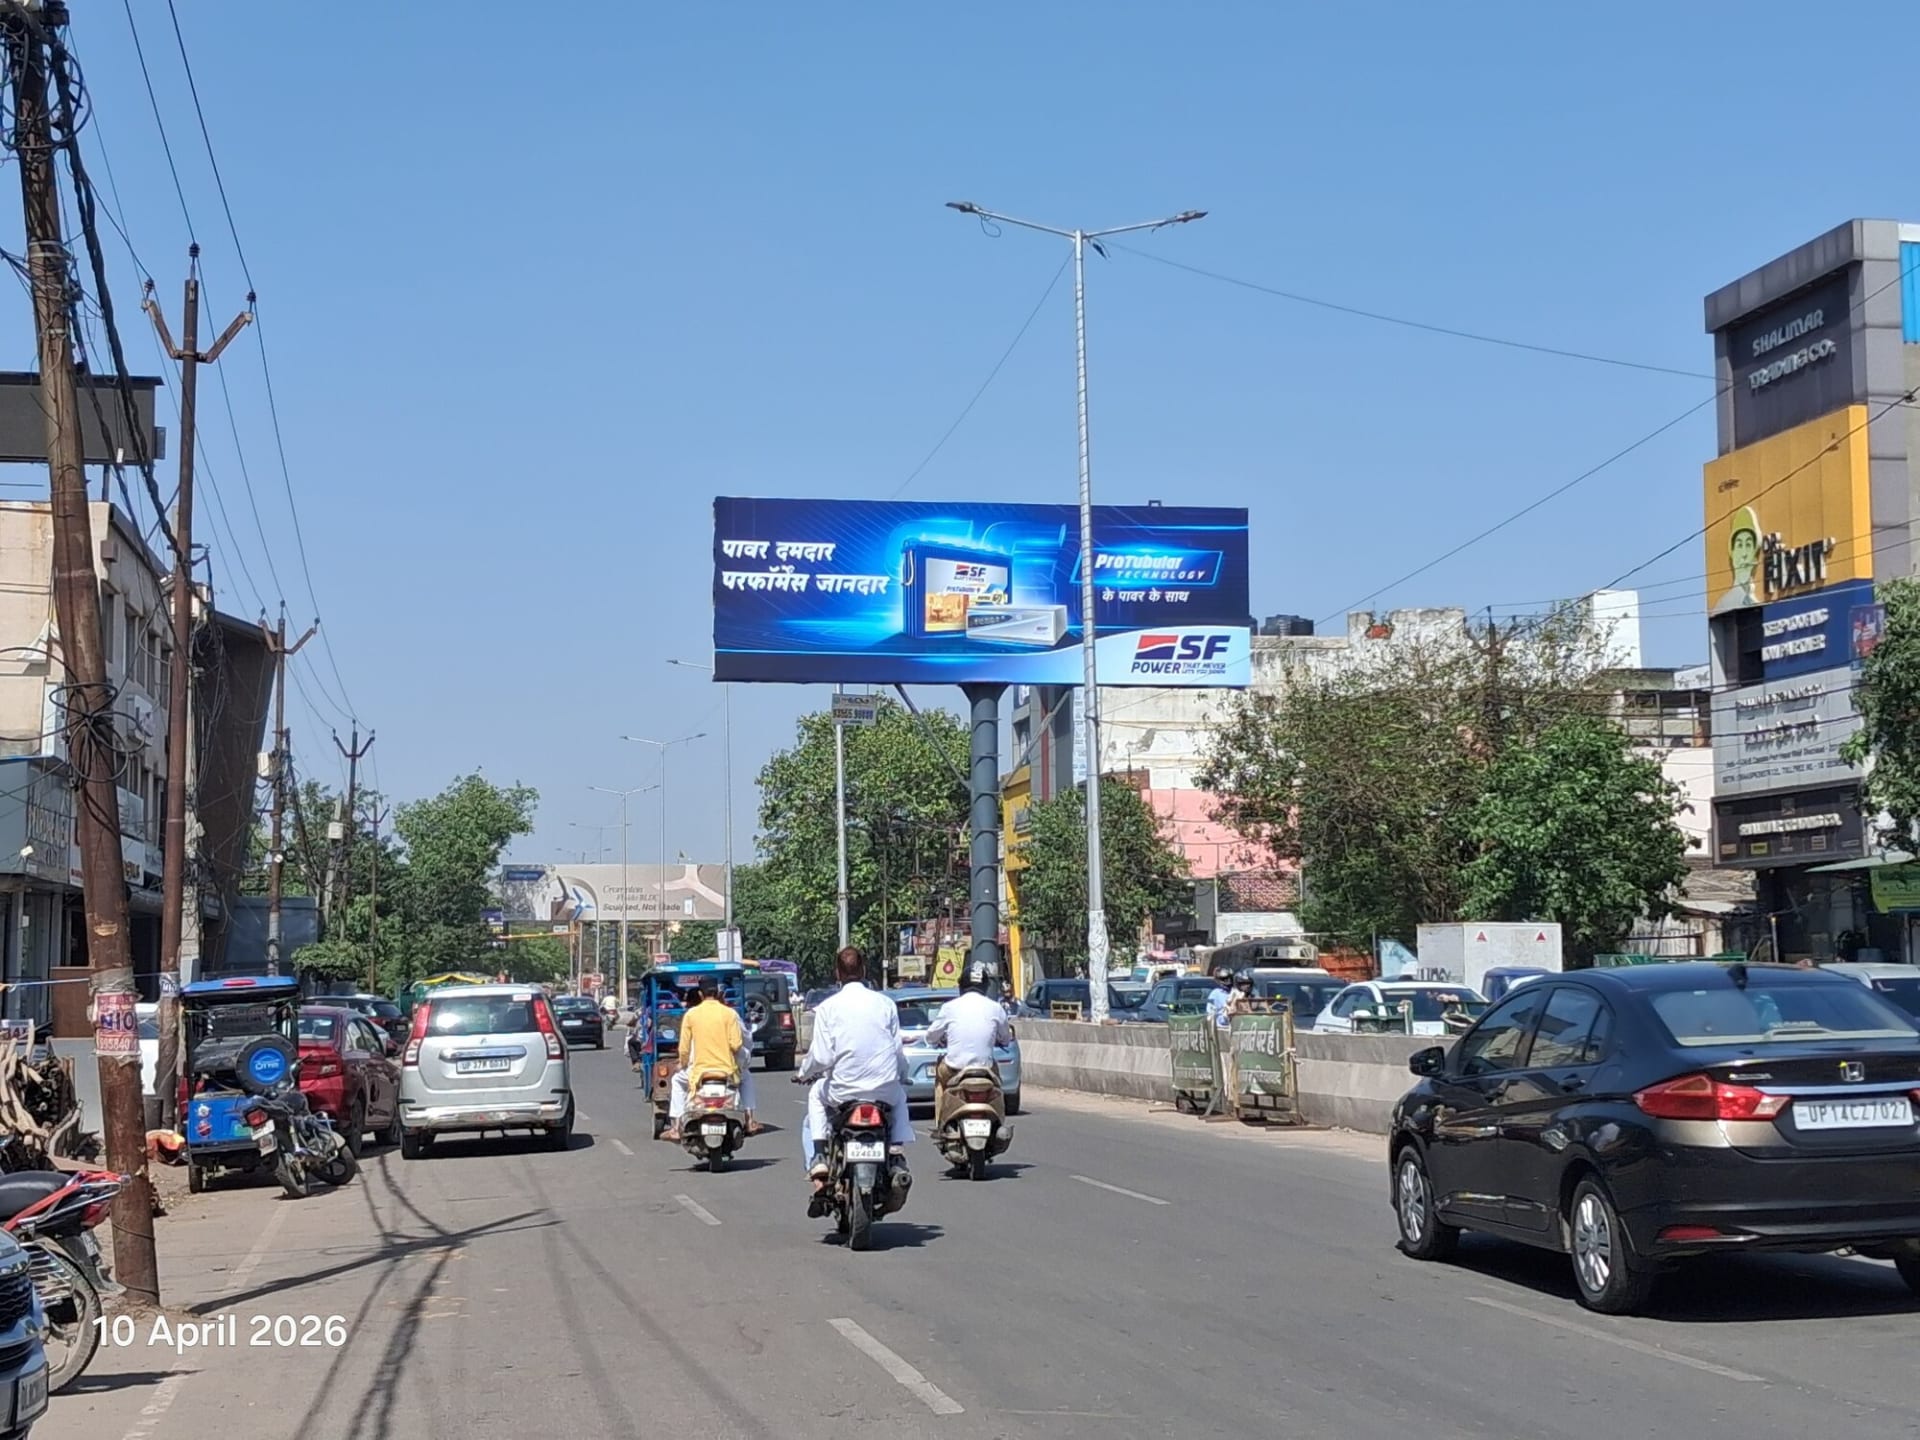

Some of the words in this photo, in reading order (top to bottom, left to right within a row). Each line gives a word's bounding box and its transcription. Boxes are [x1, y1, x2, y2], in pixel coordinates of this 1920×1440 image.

[1752, 309, 1824, 358] SHALIMAR
[1748, 347, 1809, 390] TRADING
[722, 540, 770, 560] पावर
[775, 541, 836, 562] दमदार
[1095, 553, 1183, 570] ProTubular
[969, 566, 986, 577] SF
[1117, 570, 1205, 580] TECHNOLOGY
[816, 574, 890, 595] जानदार
[1102, 586, 1115, 602] के
[1119, 591, 1146, 602] पावर
[1149, 586, 1162, 602] के
[1165, 591, 1190, 603] साथ
[1177, 635, 1231, 660] SF
[1131, 661, 1182, 675] POWER
[1808, 1101, 1908, 1123] UP14CZ7027
